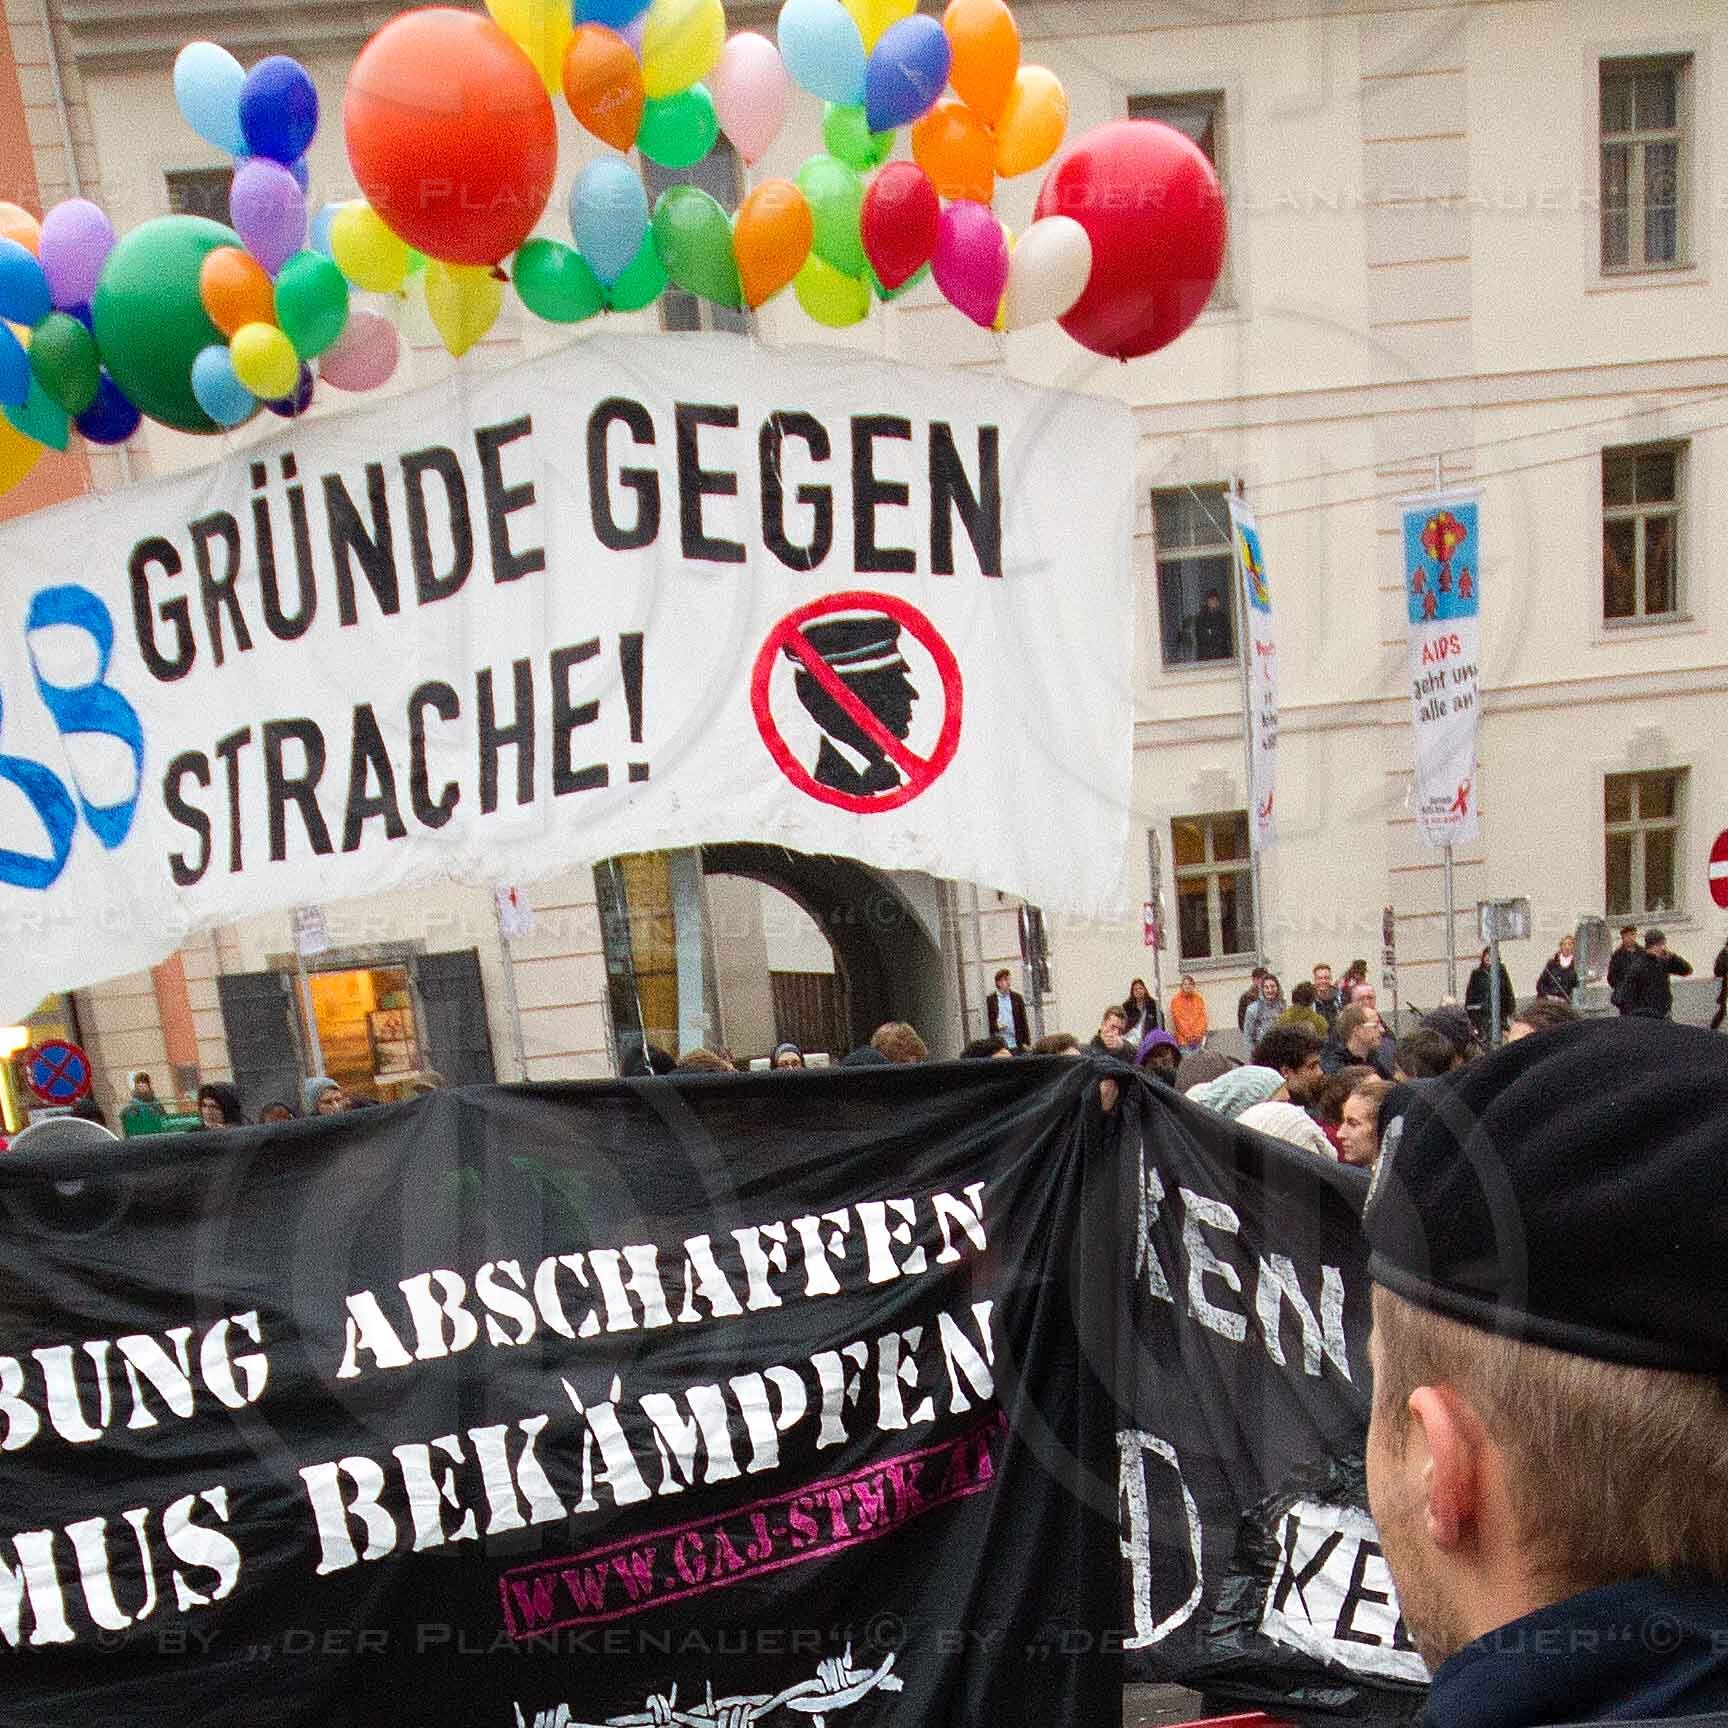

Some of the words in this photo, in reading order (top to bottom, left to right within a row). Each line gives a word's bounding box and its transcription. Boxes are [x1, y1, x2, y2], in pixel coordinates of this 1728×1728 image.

[129, 414, 547, 685] GRÜNDE
[586, 394, 1005, 578] GEGEN
[1422, 634, 1462, 665] AIDS
[162, 630, 651, 888] STRACHE!
[335, 1181, 986, 1379] ABSCHAFFEN
[298, 1300, 996, 1576] BEKÄMPFEN
[1272, 1510, 1414, 1648] KE
